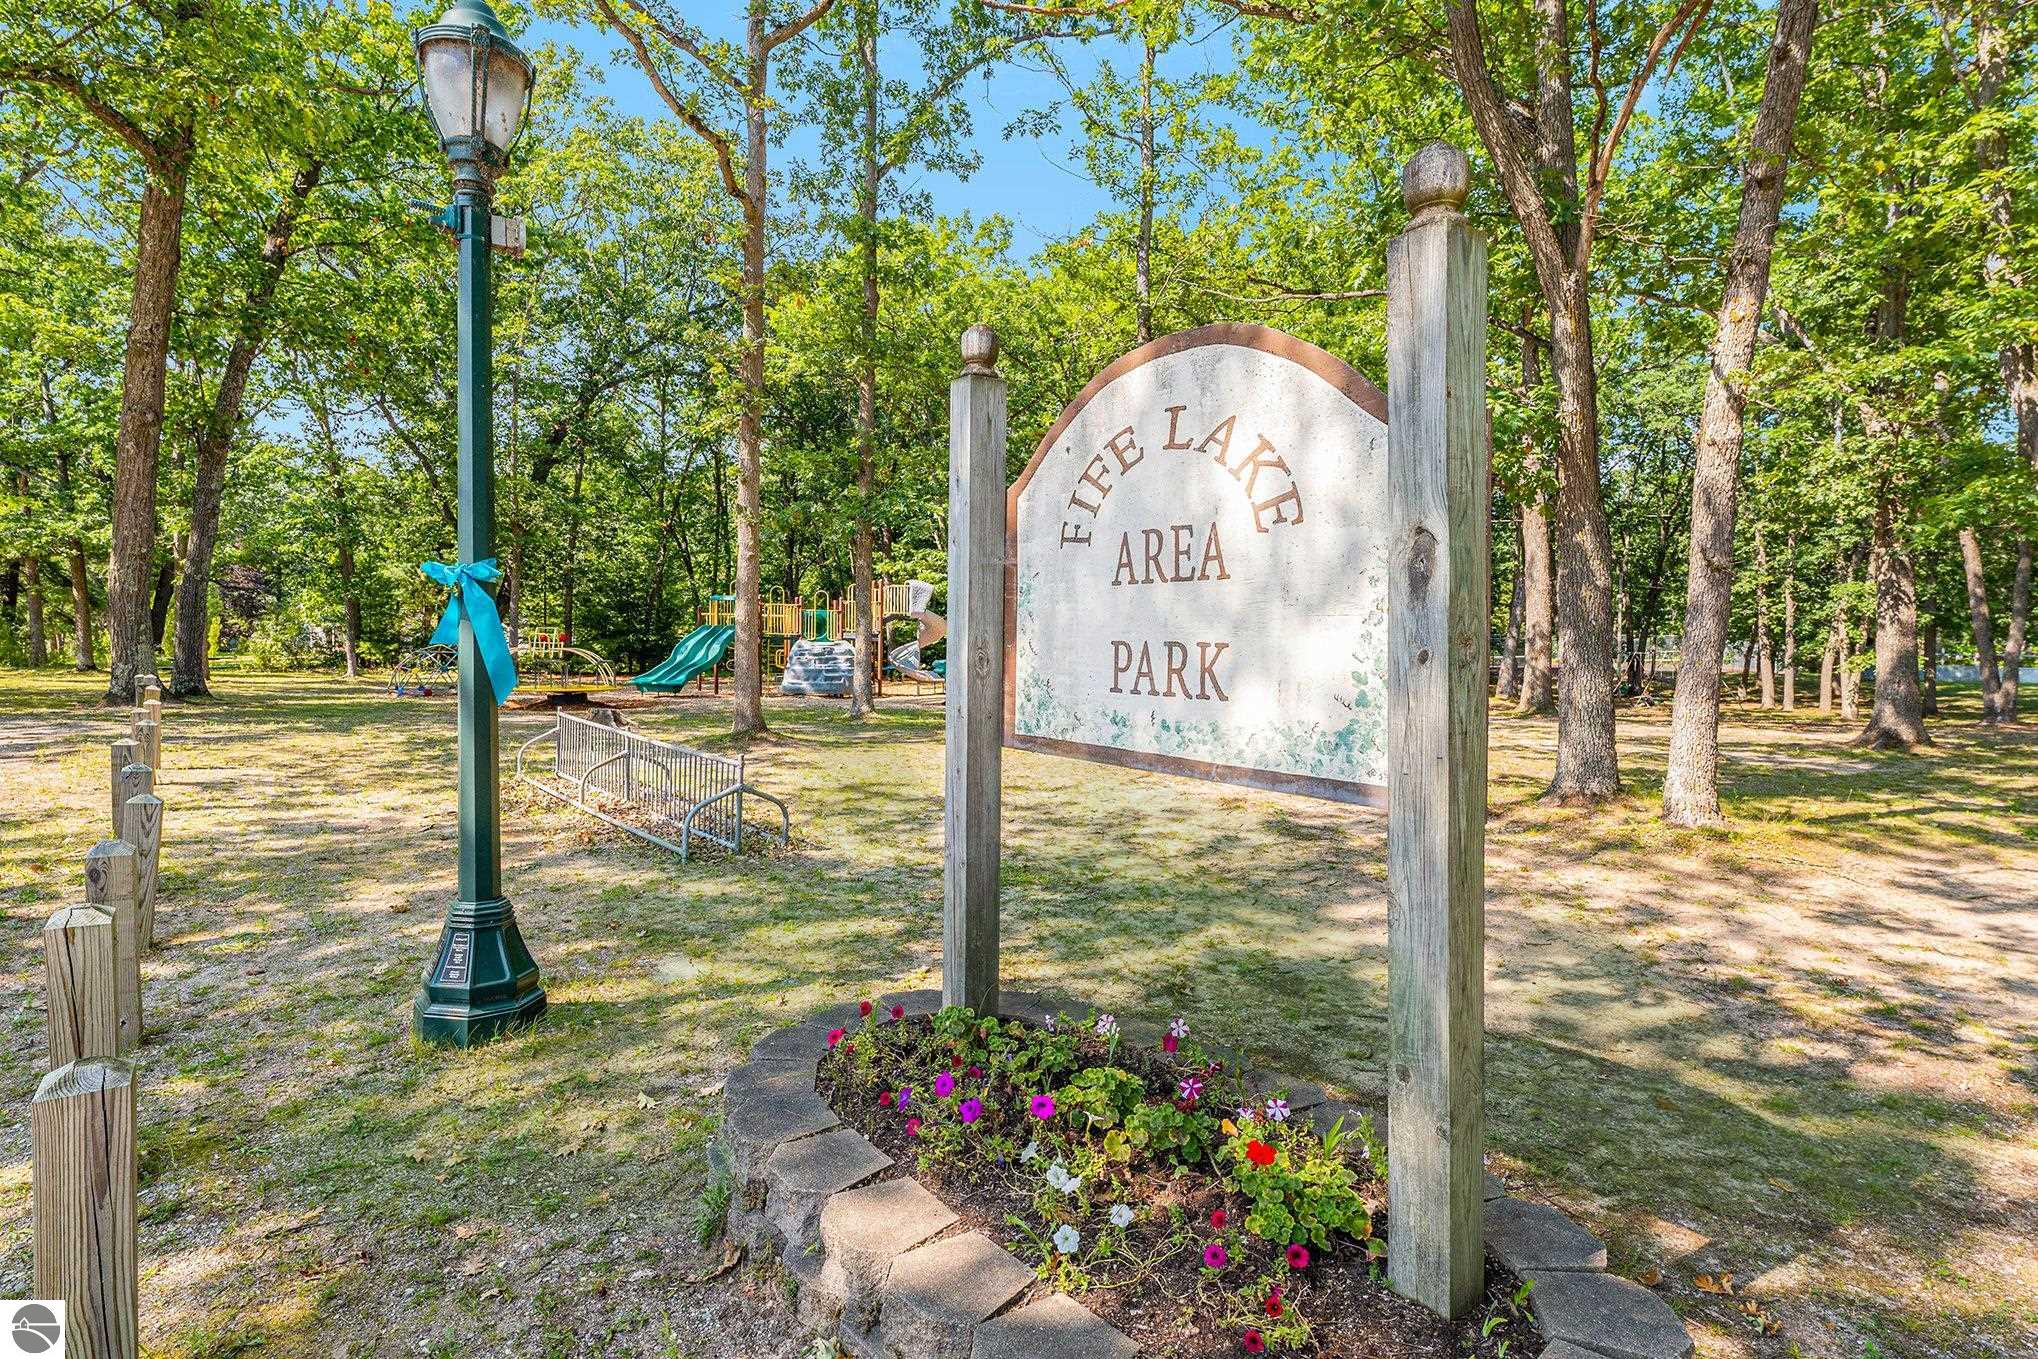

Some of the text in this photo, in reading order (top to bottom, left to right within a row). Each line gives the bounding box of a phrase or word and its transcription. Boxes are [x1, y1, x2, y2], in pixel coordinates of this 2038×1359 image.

[1060, 405, 1304, 549] FIFE LAKE
[1111, 522, 1231, 586] AREA
[1109, 640, 1229, 702] PARK
